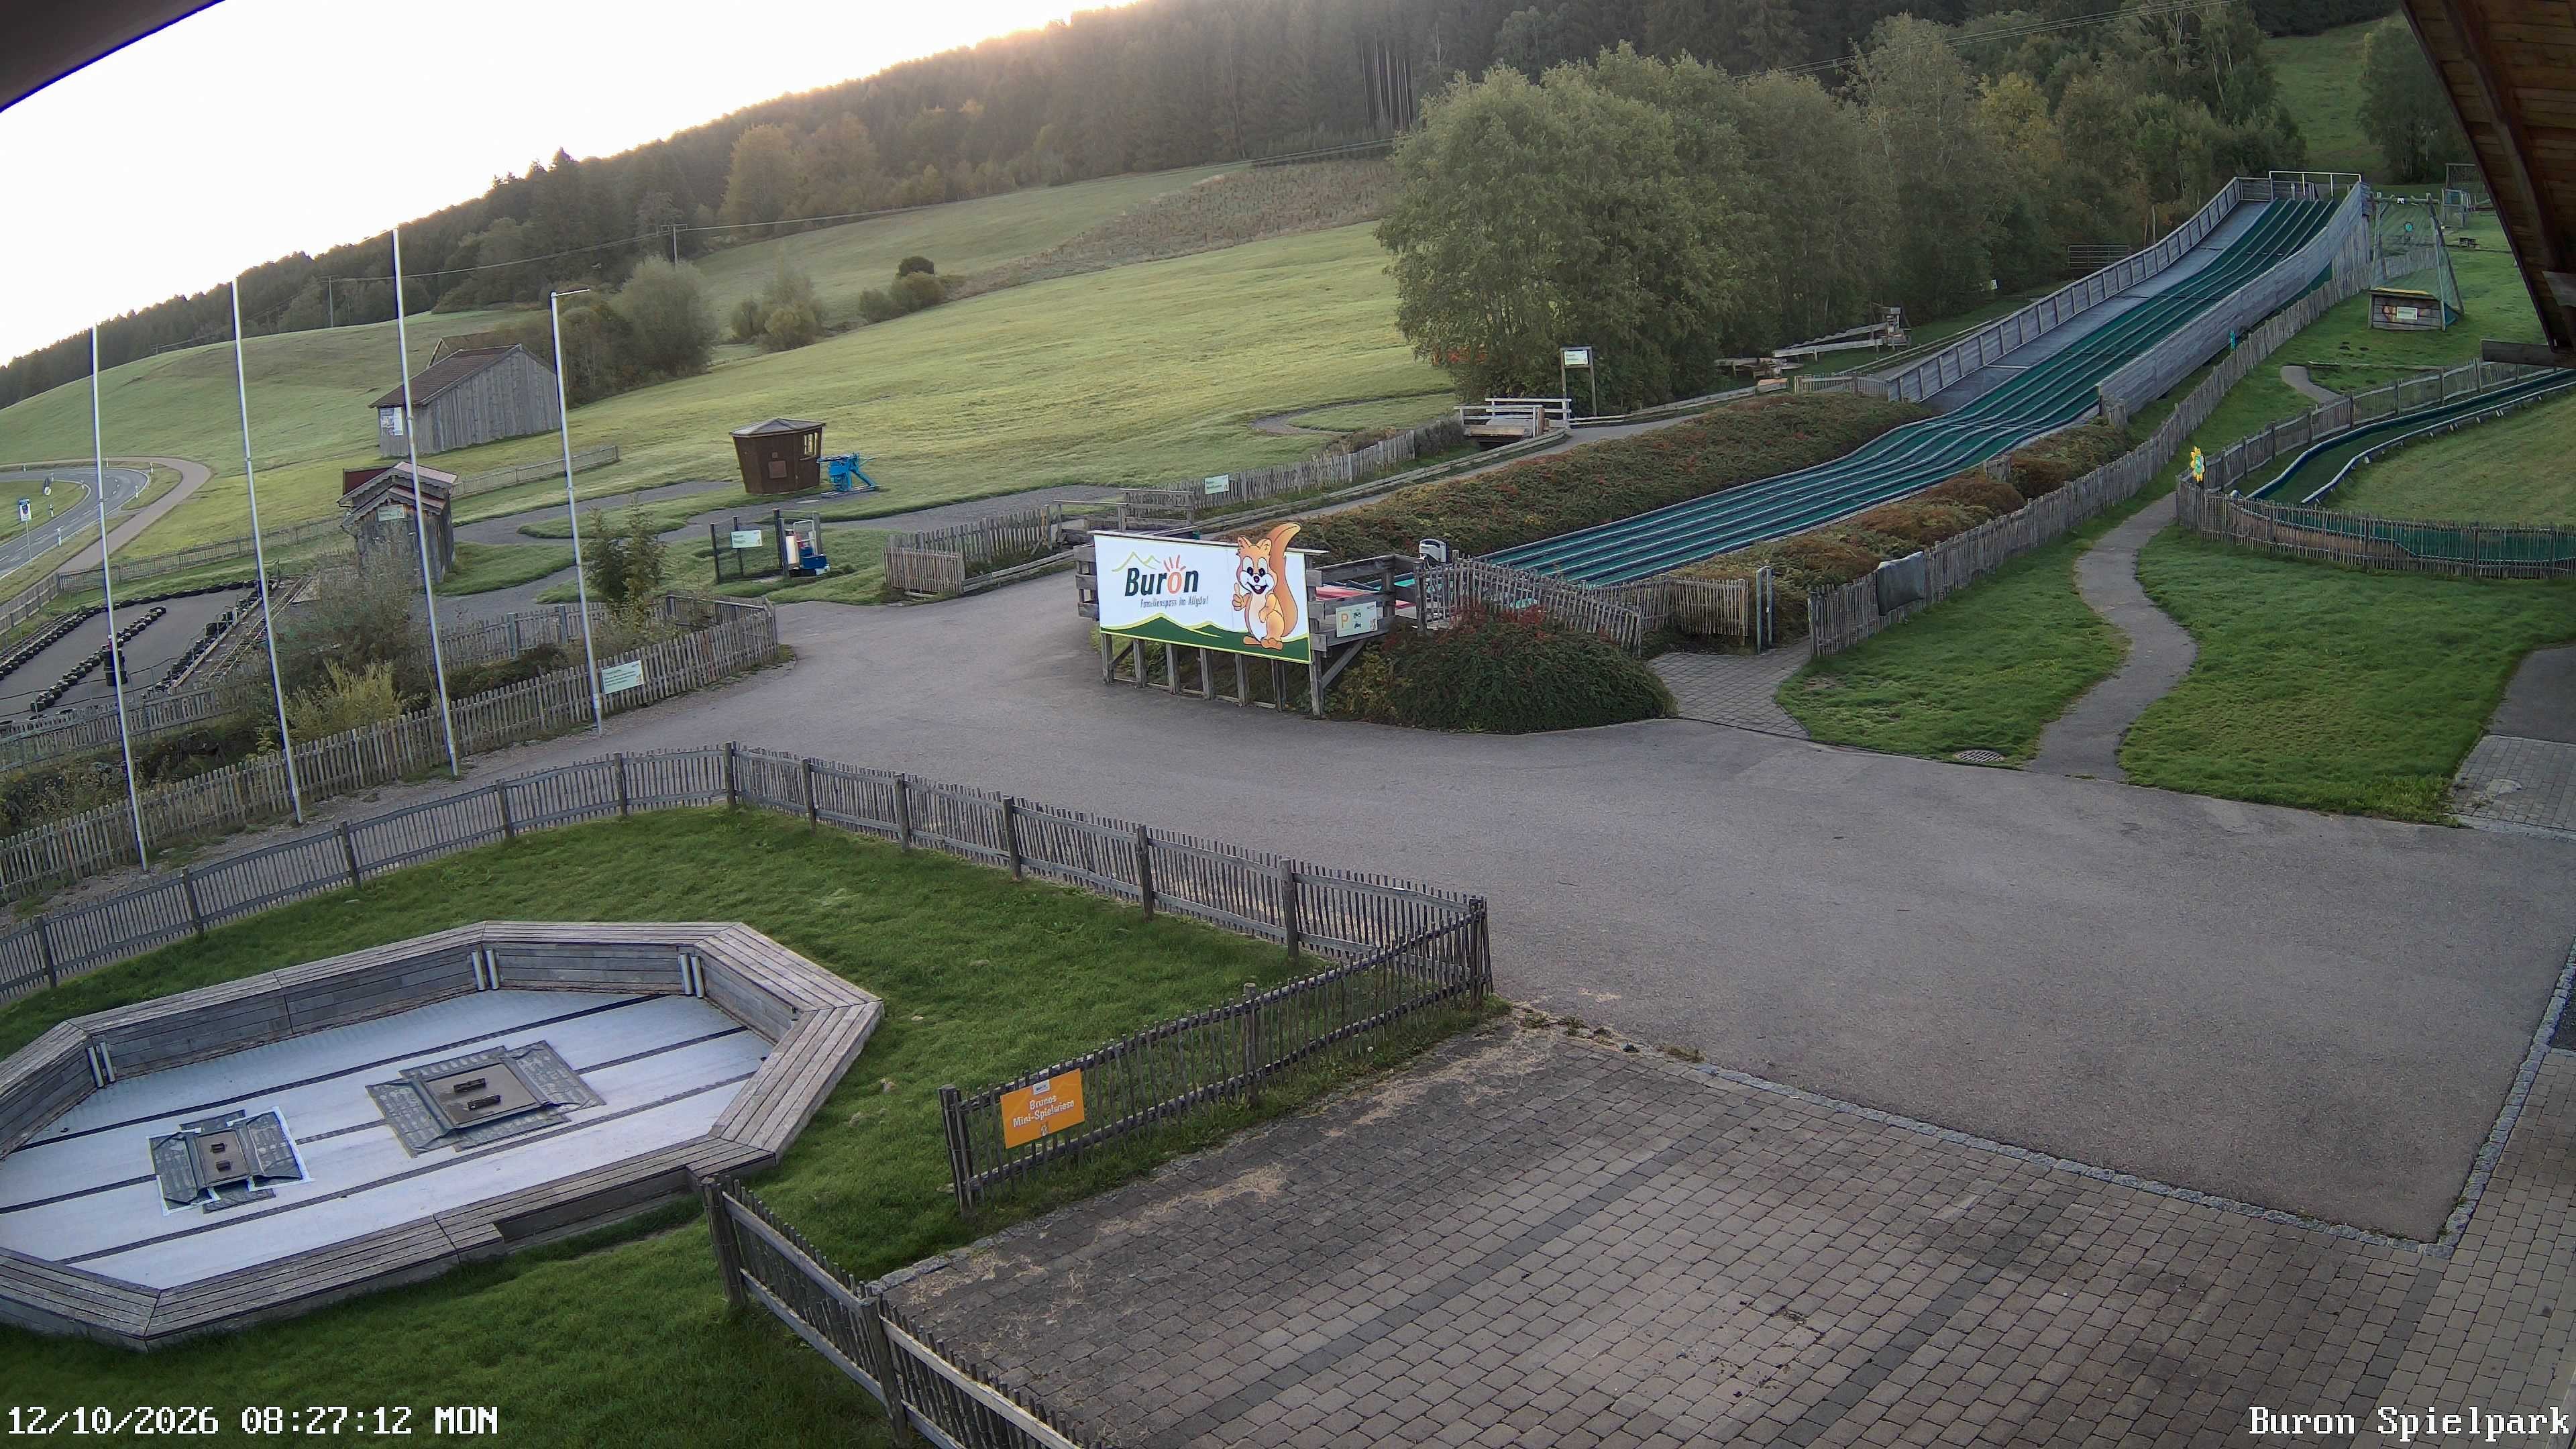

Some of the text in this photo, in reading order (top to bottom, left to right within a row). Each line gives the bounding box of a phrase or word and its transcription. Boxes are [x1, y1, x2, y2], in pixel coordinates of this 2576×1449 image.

[1124, 568, 1199, 596] Buron
[1179, 597, 1186, 606] im
[1013, 1100, 1075, 1127] Mini-Spielwiese
